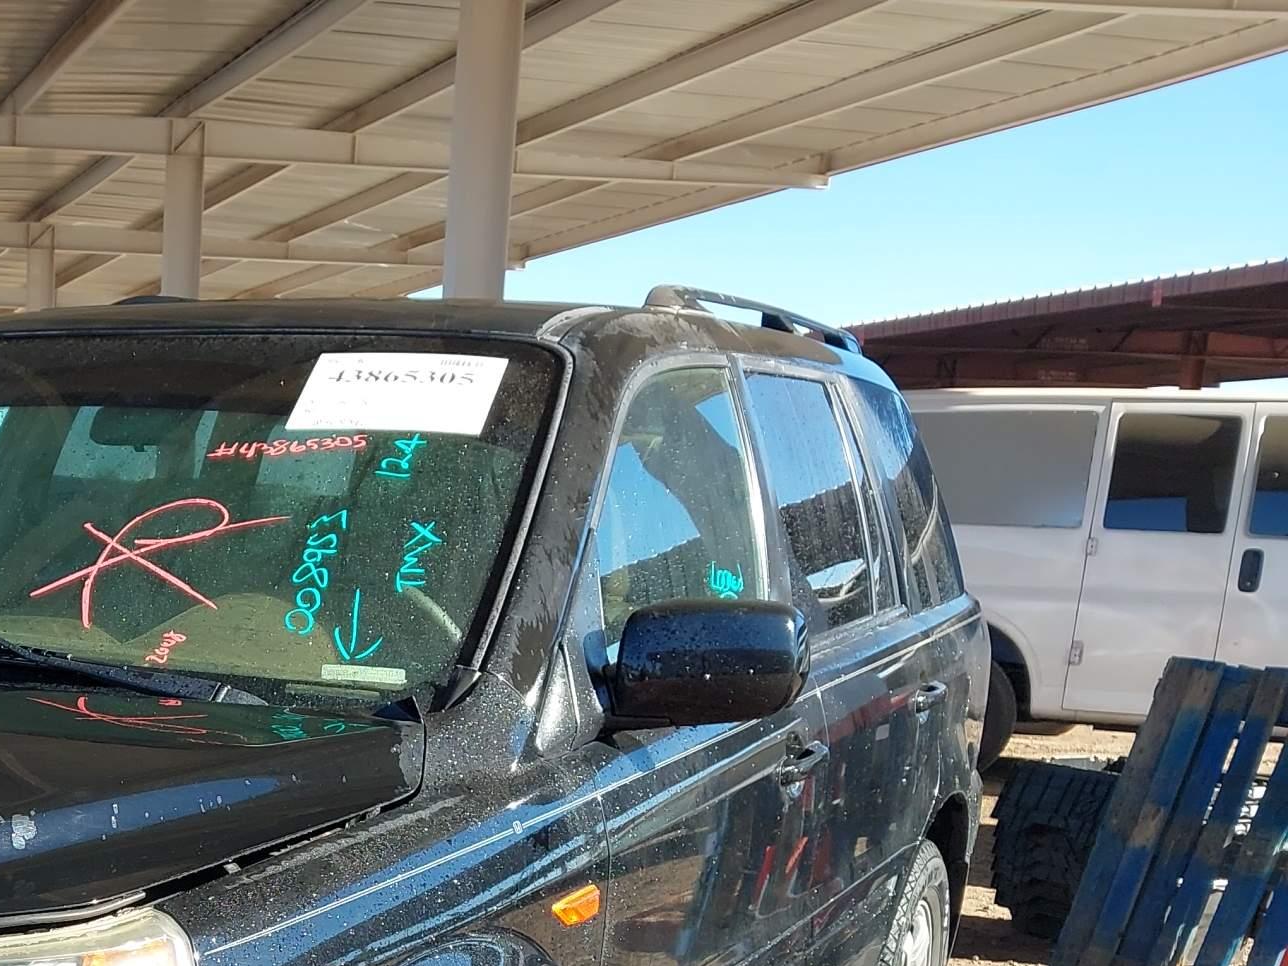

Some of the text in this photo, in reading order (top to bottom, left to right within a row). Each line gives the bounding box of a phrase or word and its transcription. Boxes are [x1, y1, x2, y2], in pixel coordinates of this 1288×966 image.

[328, 369, 475, 386] 43865305
[206, 434, 368, 458] #43865305
[284, 509, 348, 634] 008953
[395, 521, 442, 593] TMX
